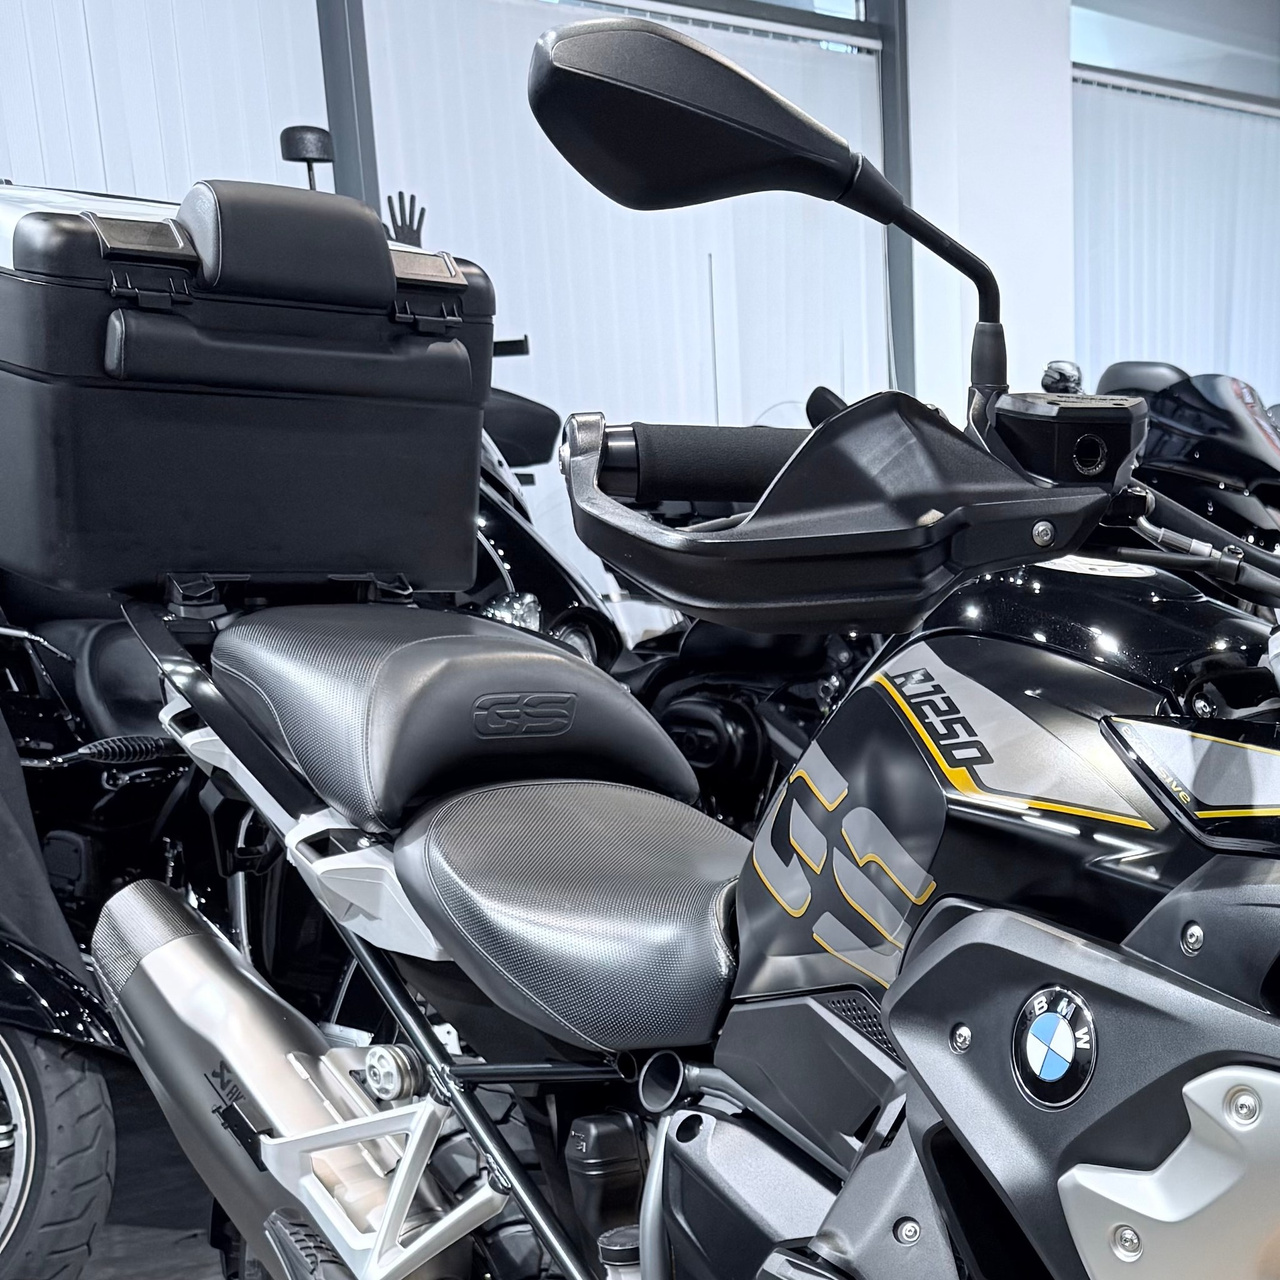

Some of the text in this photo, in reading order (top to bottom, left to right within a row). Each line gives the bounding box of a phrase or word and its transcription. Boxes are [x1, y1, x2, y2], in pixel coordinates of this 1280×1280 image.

[473, 692, 577, 738] GS
[1121, 725, 1191, 804] excsive
[1033, 995, 1091, 1050] BMW
